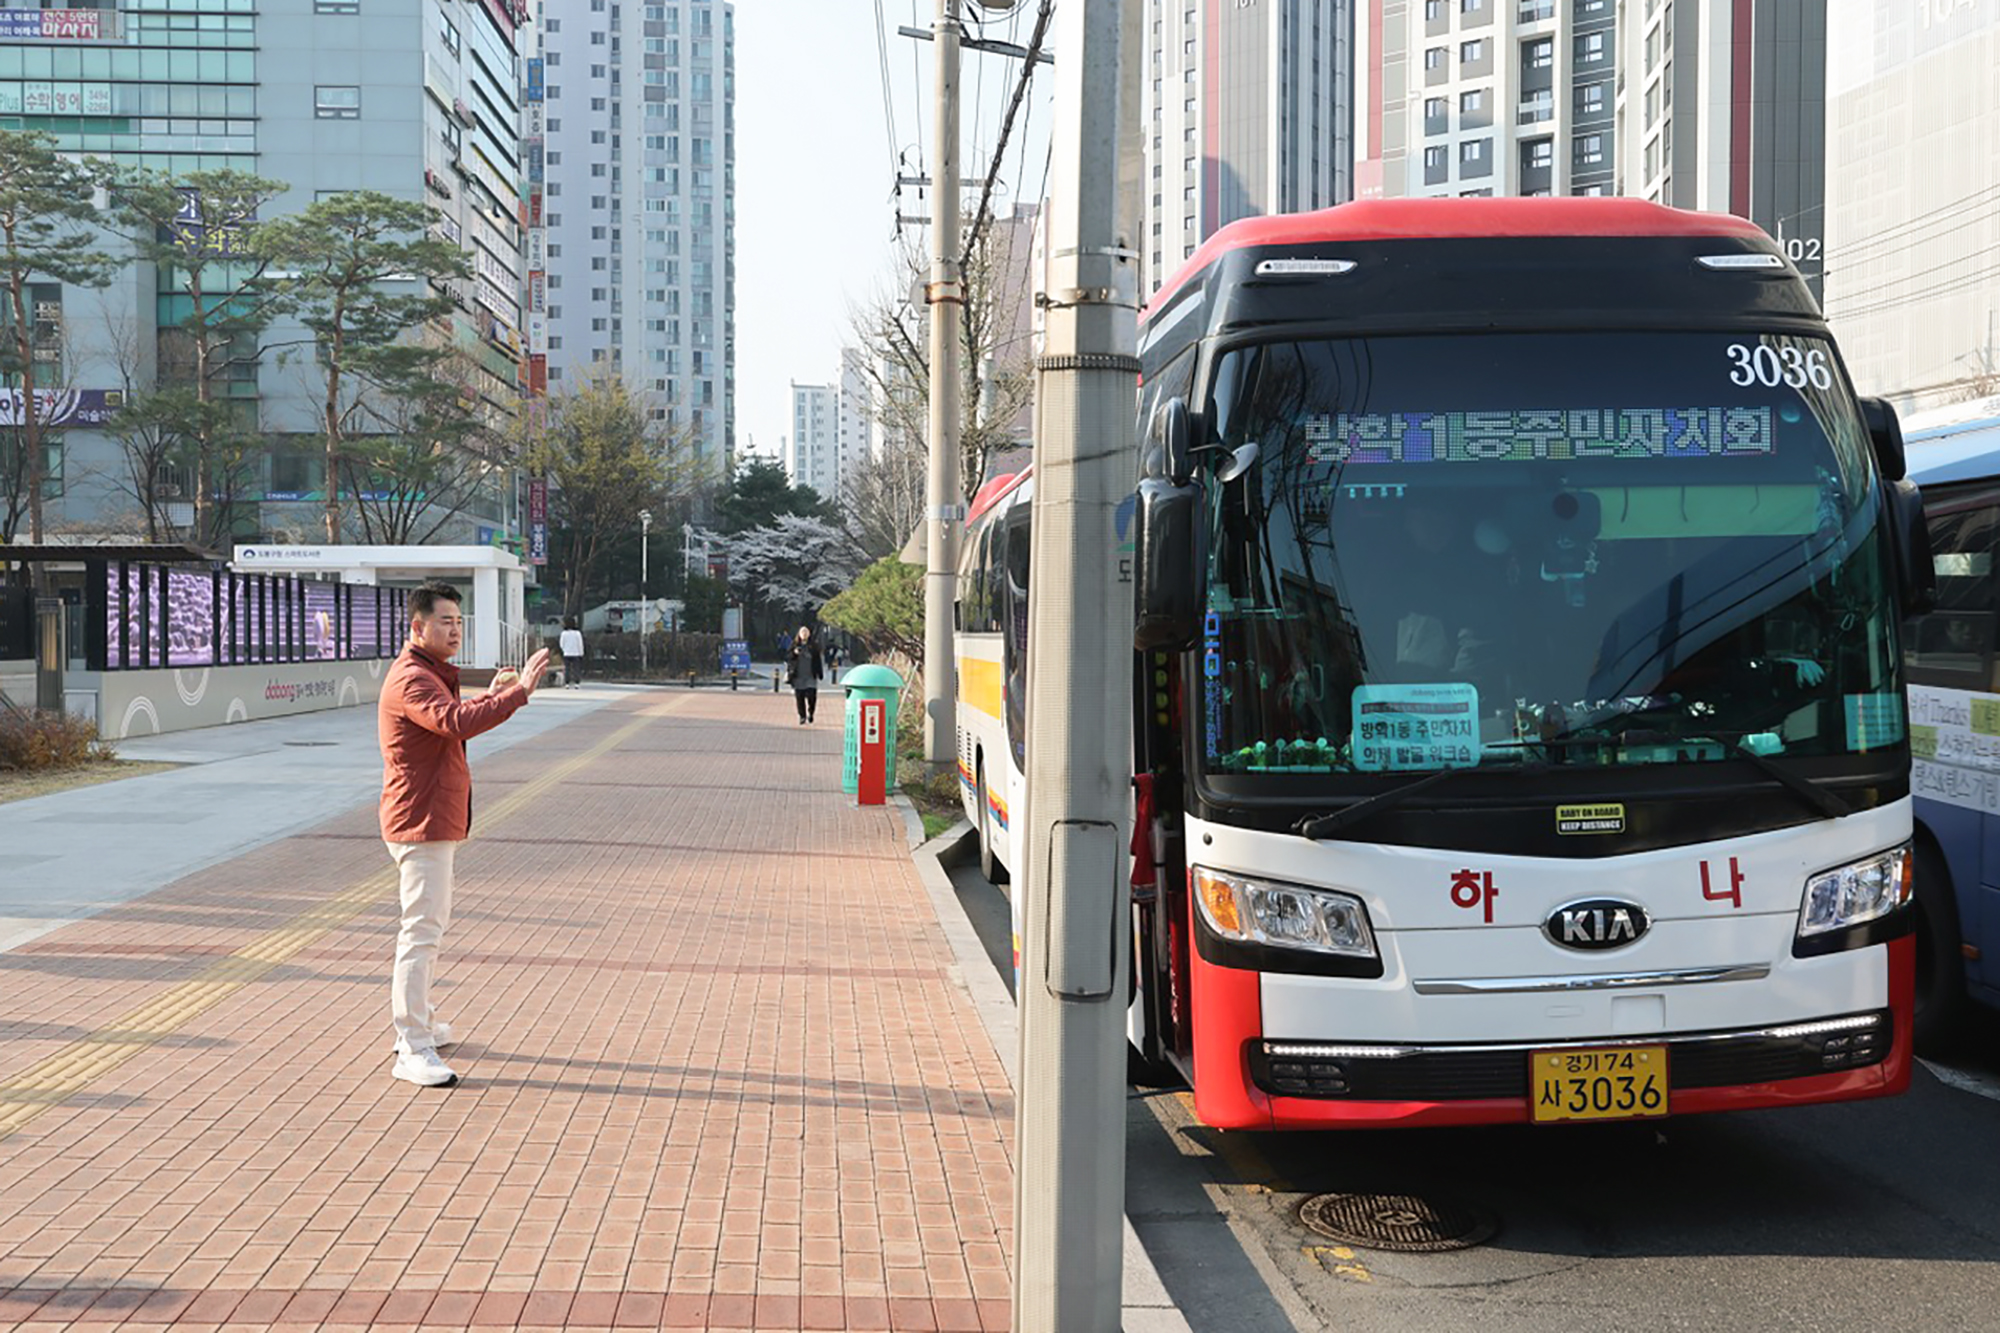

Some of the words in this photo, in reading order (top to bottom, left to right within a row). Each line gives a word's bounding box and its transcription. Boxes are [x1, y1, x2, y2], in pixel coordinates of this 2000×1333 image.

[1727, 344, 1831, 390] 3036
[1416, 719, 1472, 738] 주민자치
[1561, 821, 1580, 830] KEEP
[1581, 820, 1620, 829] DISTANCE
[1451, 869, 1498, 923] 하
[1700, 857, 1744, 908] 나
[1562, 909, 1636, 942] KIA
